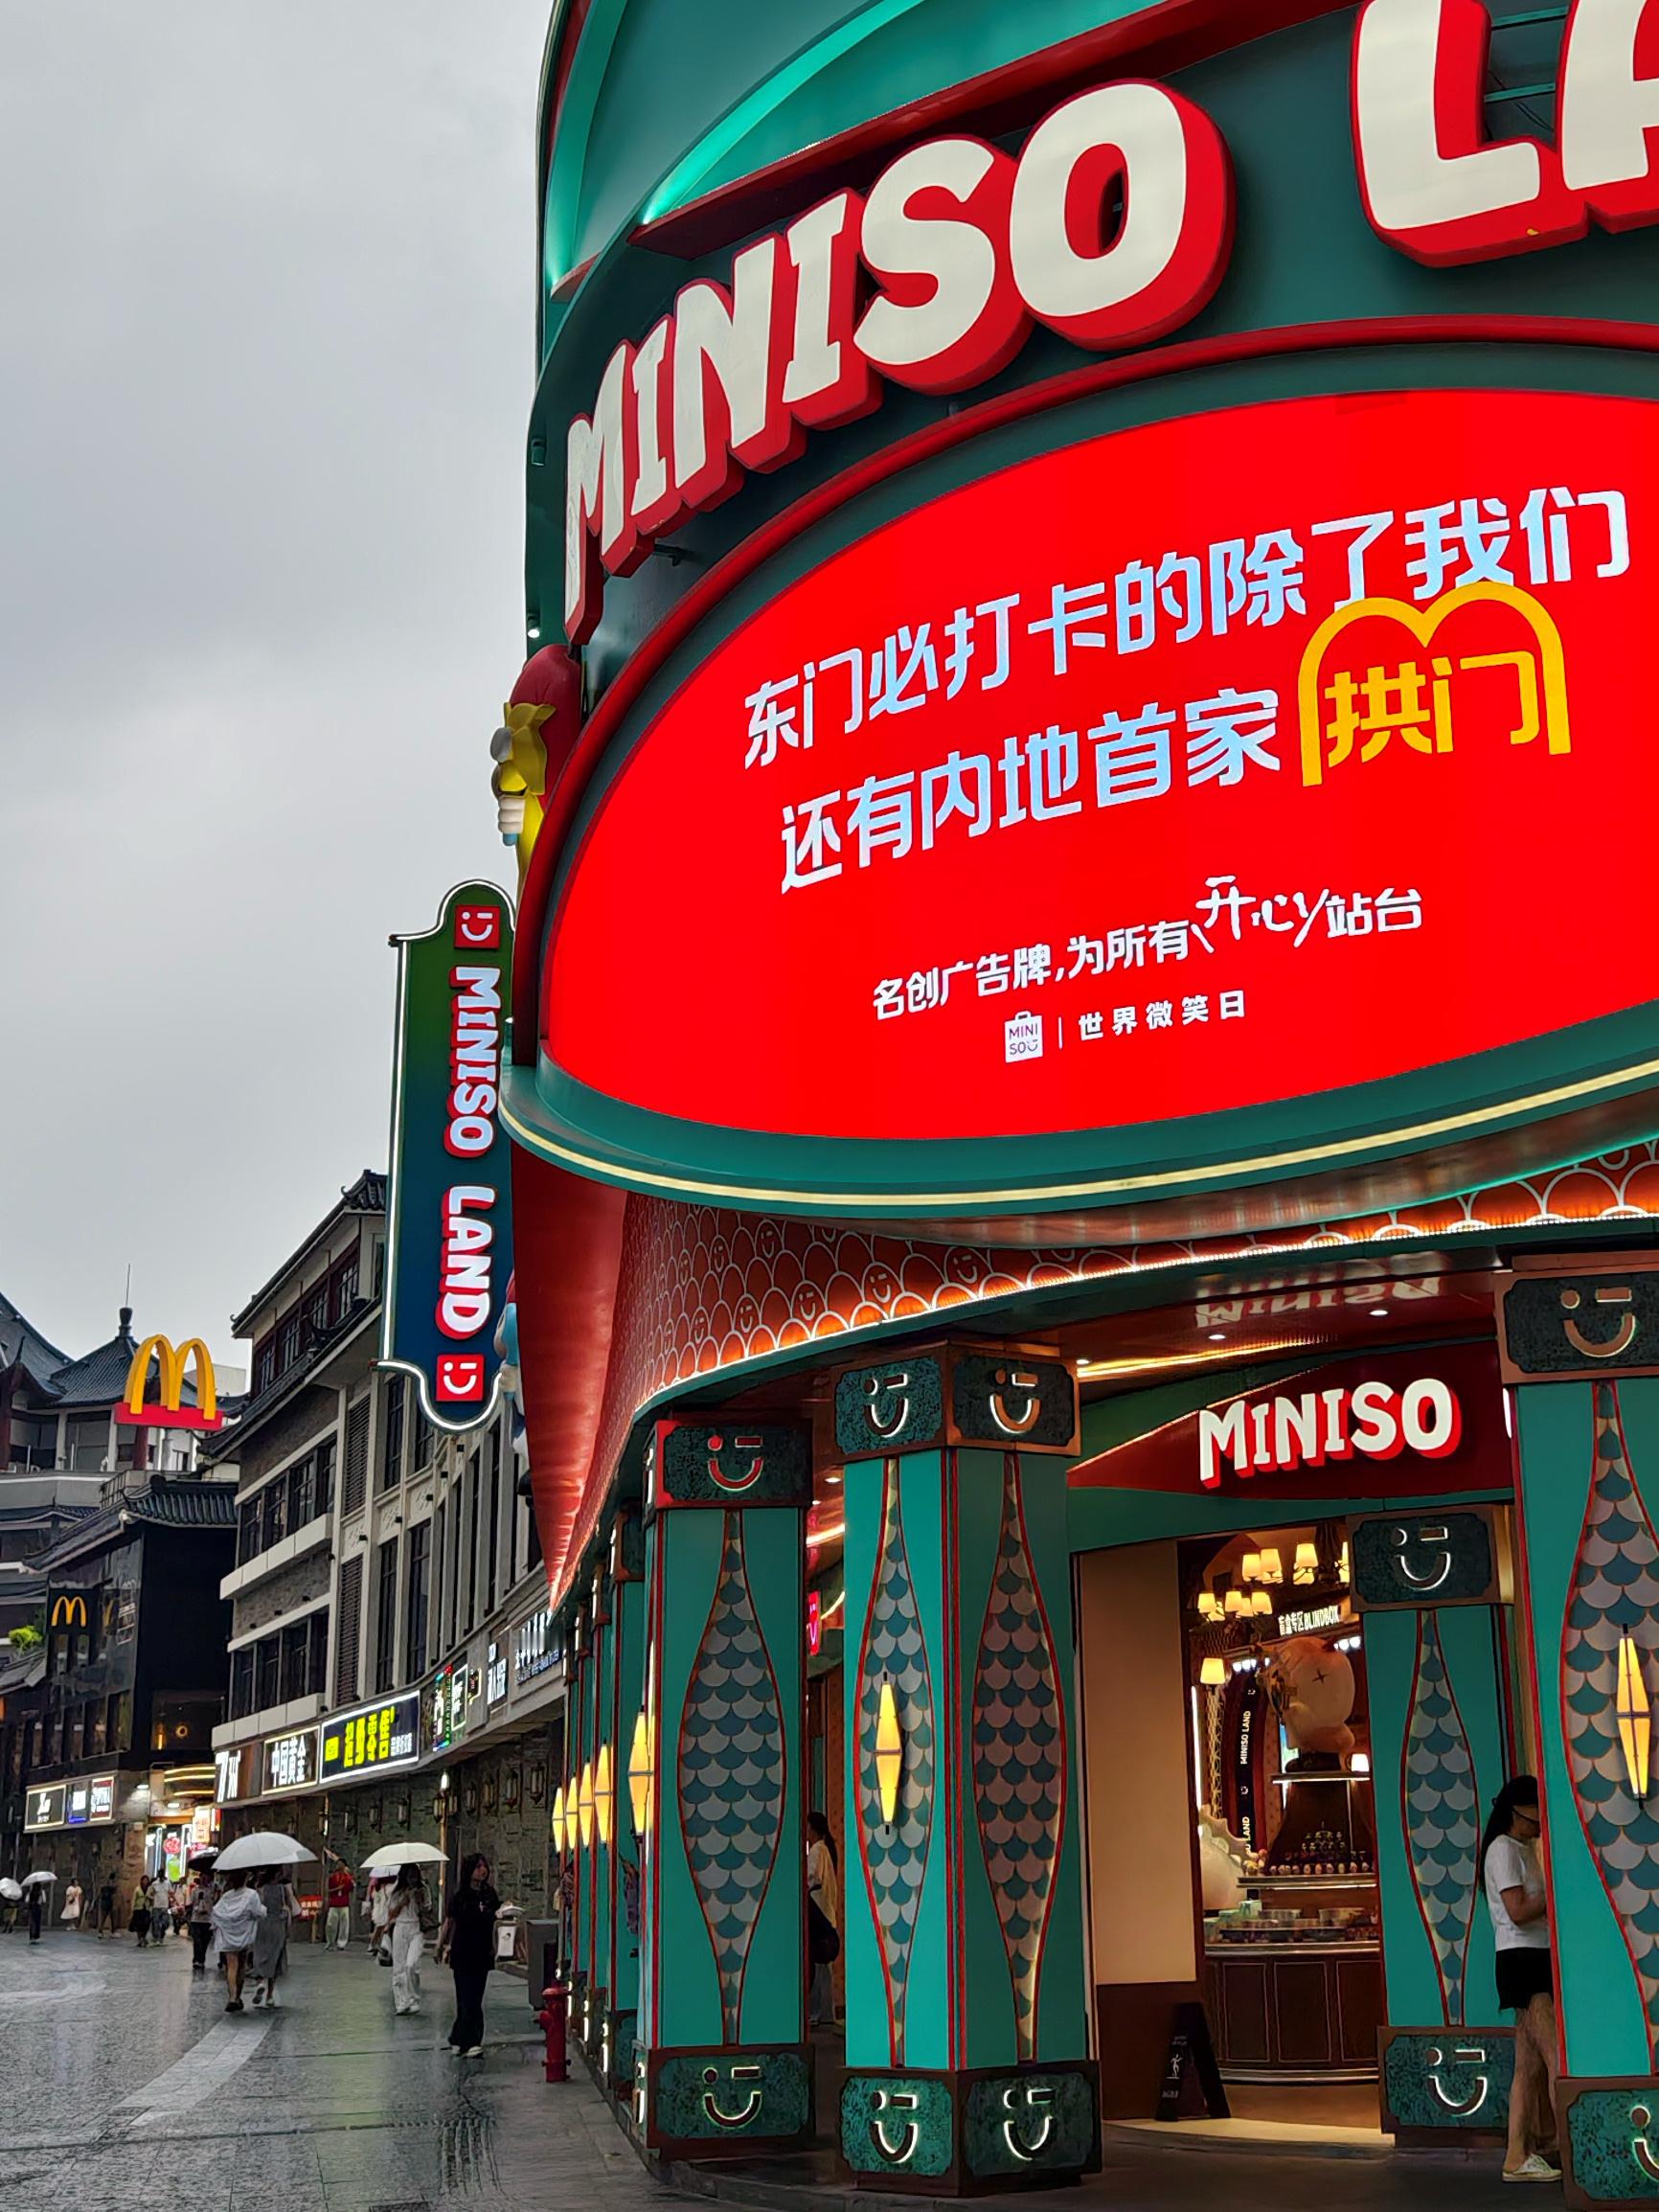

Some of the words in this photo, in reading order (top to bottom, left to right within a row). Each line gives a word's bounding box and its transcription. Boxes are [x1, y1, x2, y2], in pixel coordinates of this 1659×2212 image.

[565, 79, 1190, 627] MINISO
[744, 487, 1631, 768] 东门必打卡的除了我们
[781, 687, 1282, 895] 还有内地首家
[1324, 650, 1540, 768] 拱门
[449, 966, 502, 1151] MINISO
[1009, 1022, 1038, 1040] MINI
[1078, 990, 1245, 1041] 世界微笑日
[442, 1185, 495, 1335] LAND
[1199, 1378, 1454, 1482] MINISO
[271, 1735, 307, 1788] 中国黄金
[1239, 1734, 1249, 1765] MINISO
[1241, 1710, 1251, 1733] LAND
